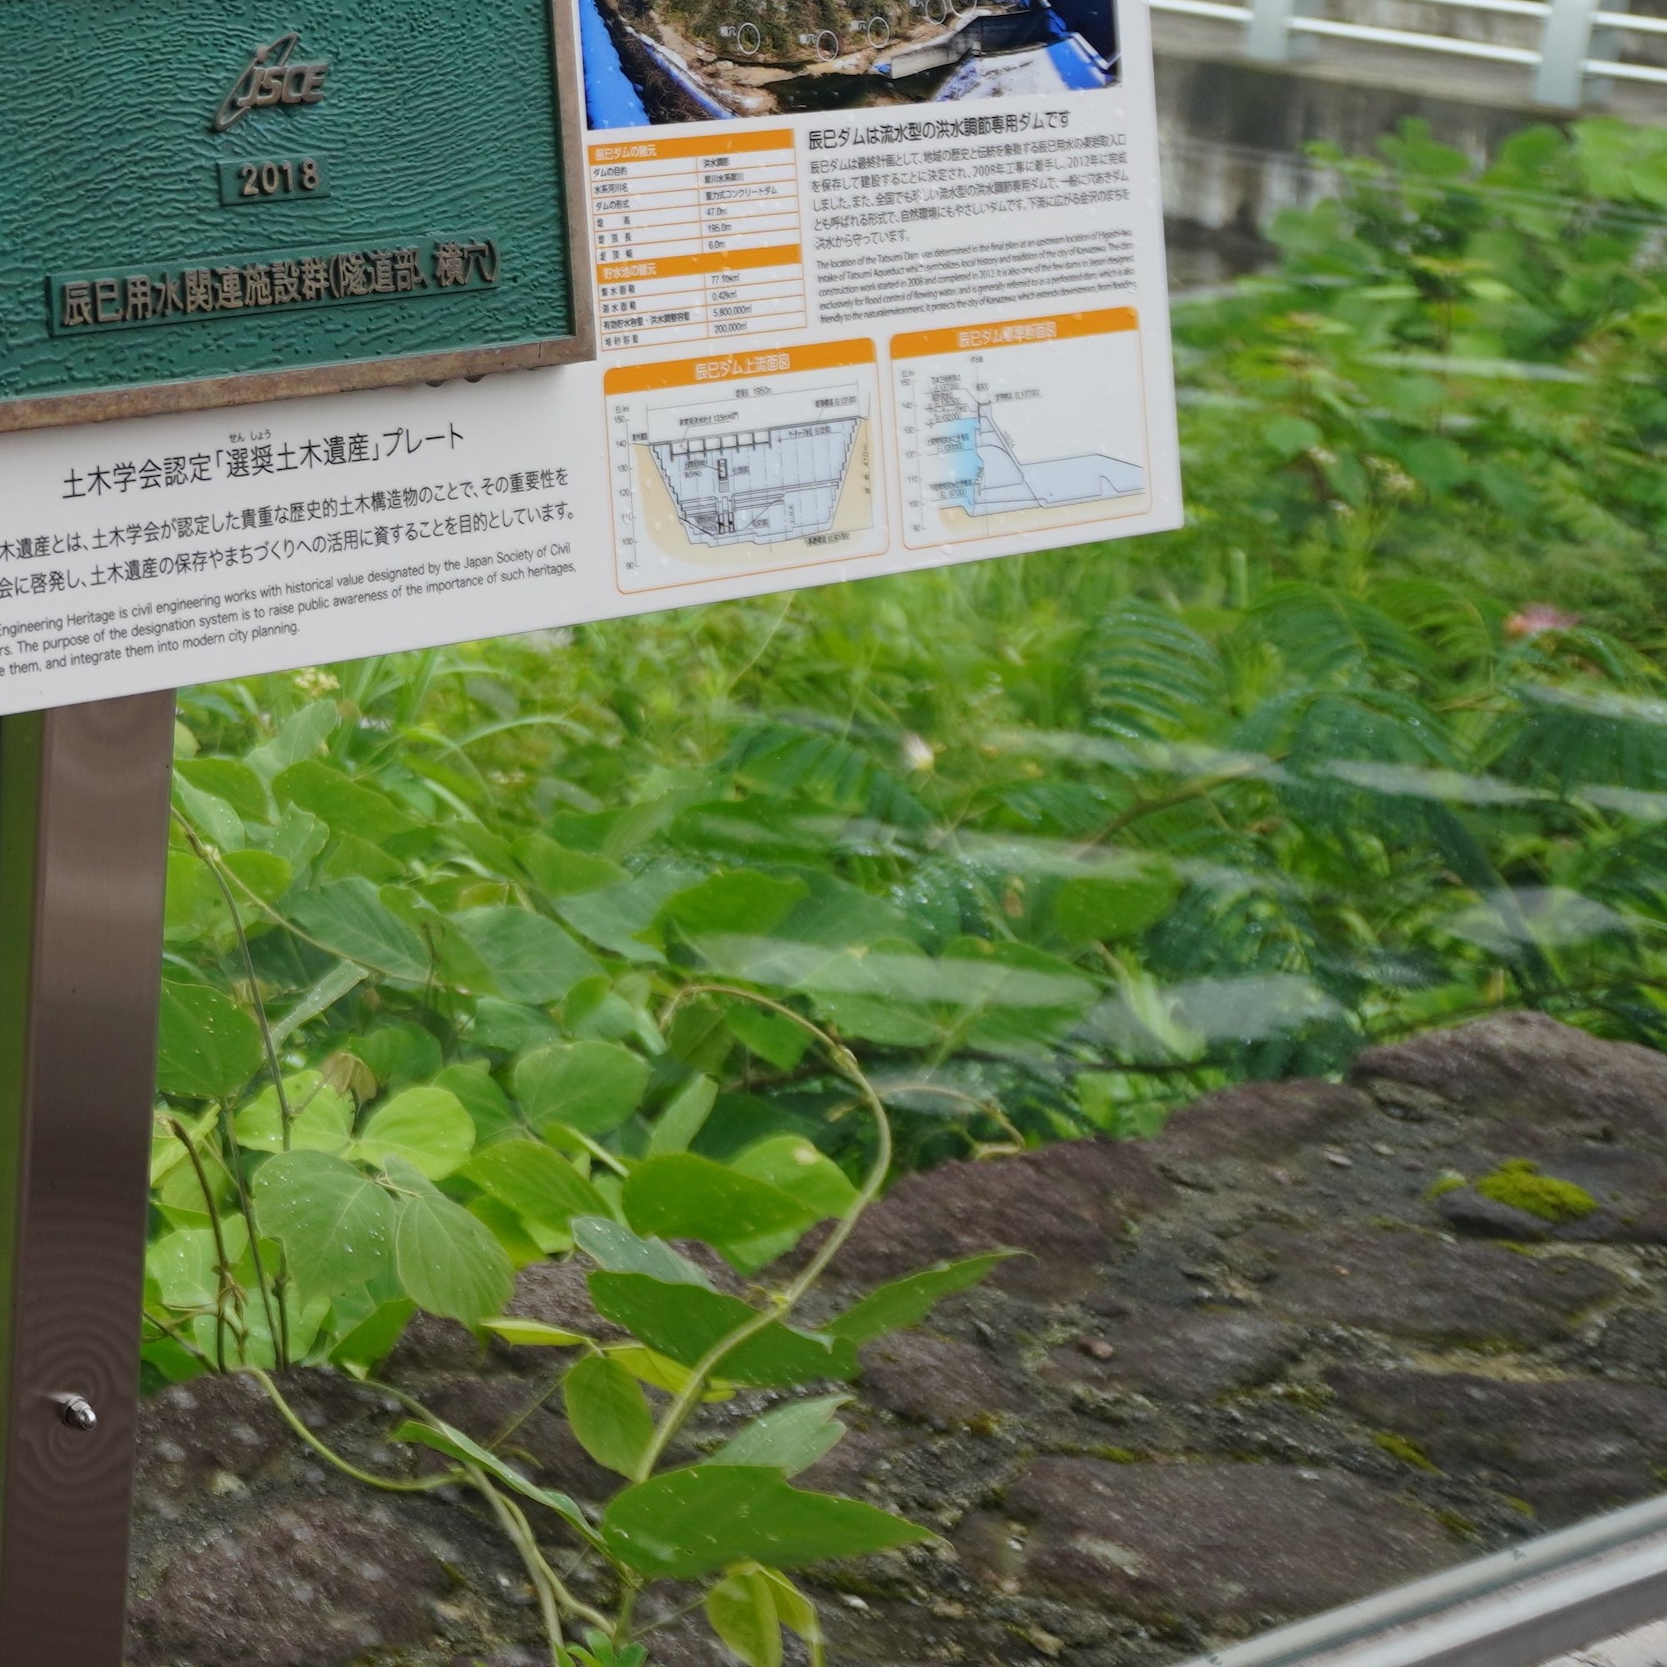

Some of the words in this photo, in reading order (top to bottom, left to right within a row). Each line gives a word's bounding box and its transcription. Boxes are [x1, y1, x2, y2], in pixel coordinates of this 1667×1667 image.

[236, 61, 329, 109] JSCE
[240, 159, 322, 198] 2018
[708, 239, 726, 250] 6.0m
[62, 422, 464, 499] 土木学会認定「選奨土木遺産」プレート
[16, 640, 39, 653] The
[42, 634, 90, 653] purpose
[93, 628, 106, 643] of
[108, 627, 128, 641] the
[130, 618, 196, 638] designation
[198, 612, 239, 630] system
[241, 608, 251, 621] is
[253, 607, 266, 619] to
[268, 604, 295, 617] raise
[297, 597, 330, 615] public
[332, 590, 389, 607] awareness
[391, 584, 403, 599] of
[405, 583, 423, 596] the
[426, 576, 484, 594] importance
[486, 570, 498, 585] of
[500, 567, 525, 582] such
[527, 562, 577, 578] heritages,
[66, 610, 116, 627] Heritage
[118, 608, 129, 619] is
[131, 602, 153, 618] civil
[155, 595, 221, 615] engineering
[223, 588, 258, 604] works
[259, 584, 283, 598] with
[285, 576, 334, 595] historical
[336, 573, 365, 587] value
[367, 563, 425, 583] designated
[427, 562, 441, 576] by
[443, 559, 461, 572] the
[463, 556, 494, 570] Japan
[496, 549, 534, 564] Society
[536, 544, 548, 559] of
[550, 542, 571, 557] Civil
[8, 661, 42, 676] them,
[45, 654, 67, 670] and
[70, 648, 122, 666] integrate
[124, 644, 155, 658] them
[157, 640, 179, 653] into
[182, 633, 225, 649] modern
[228, 628, 249, 644] city
[251, 622, 298, 642] planning.
